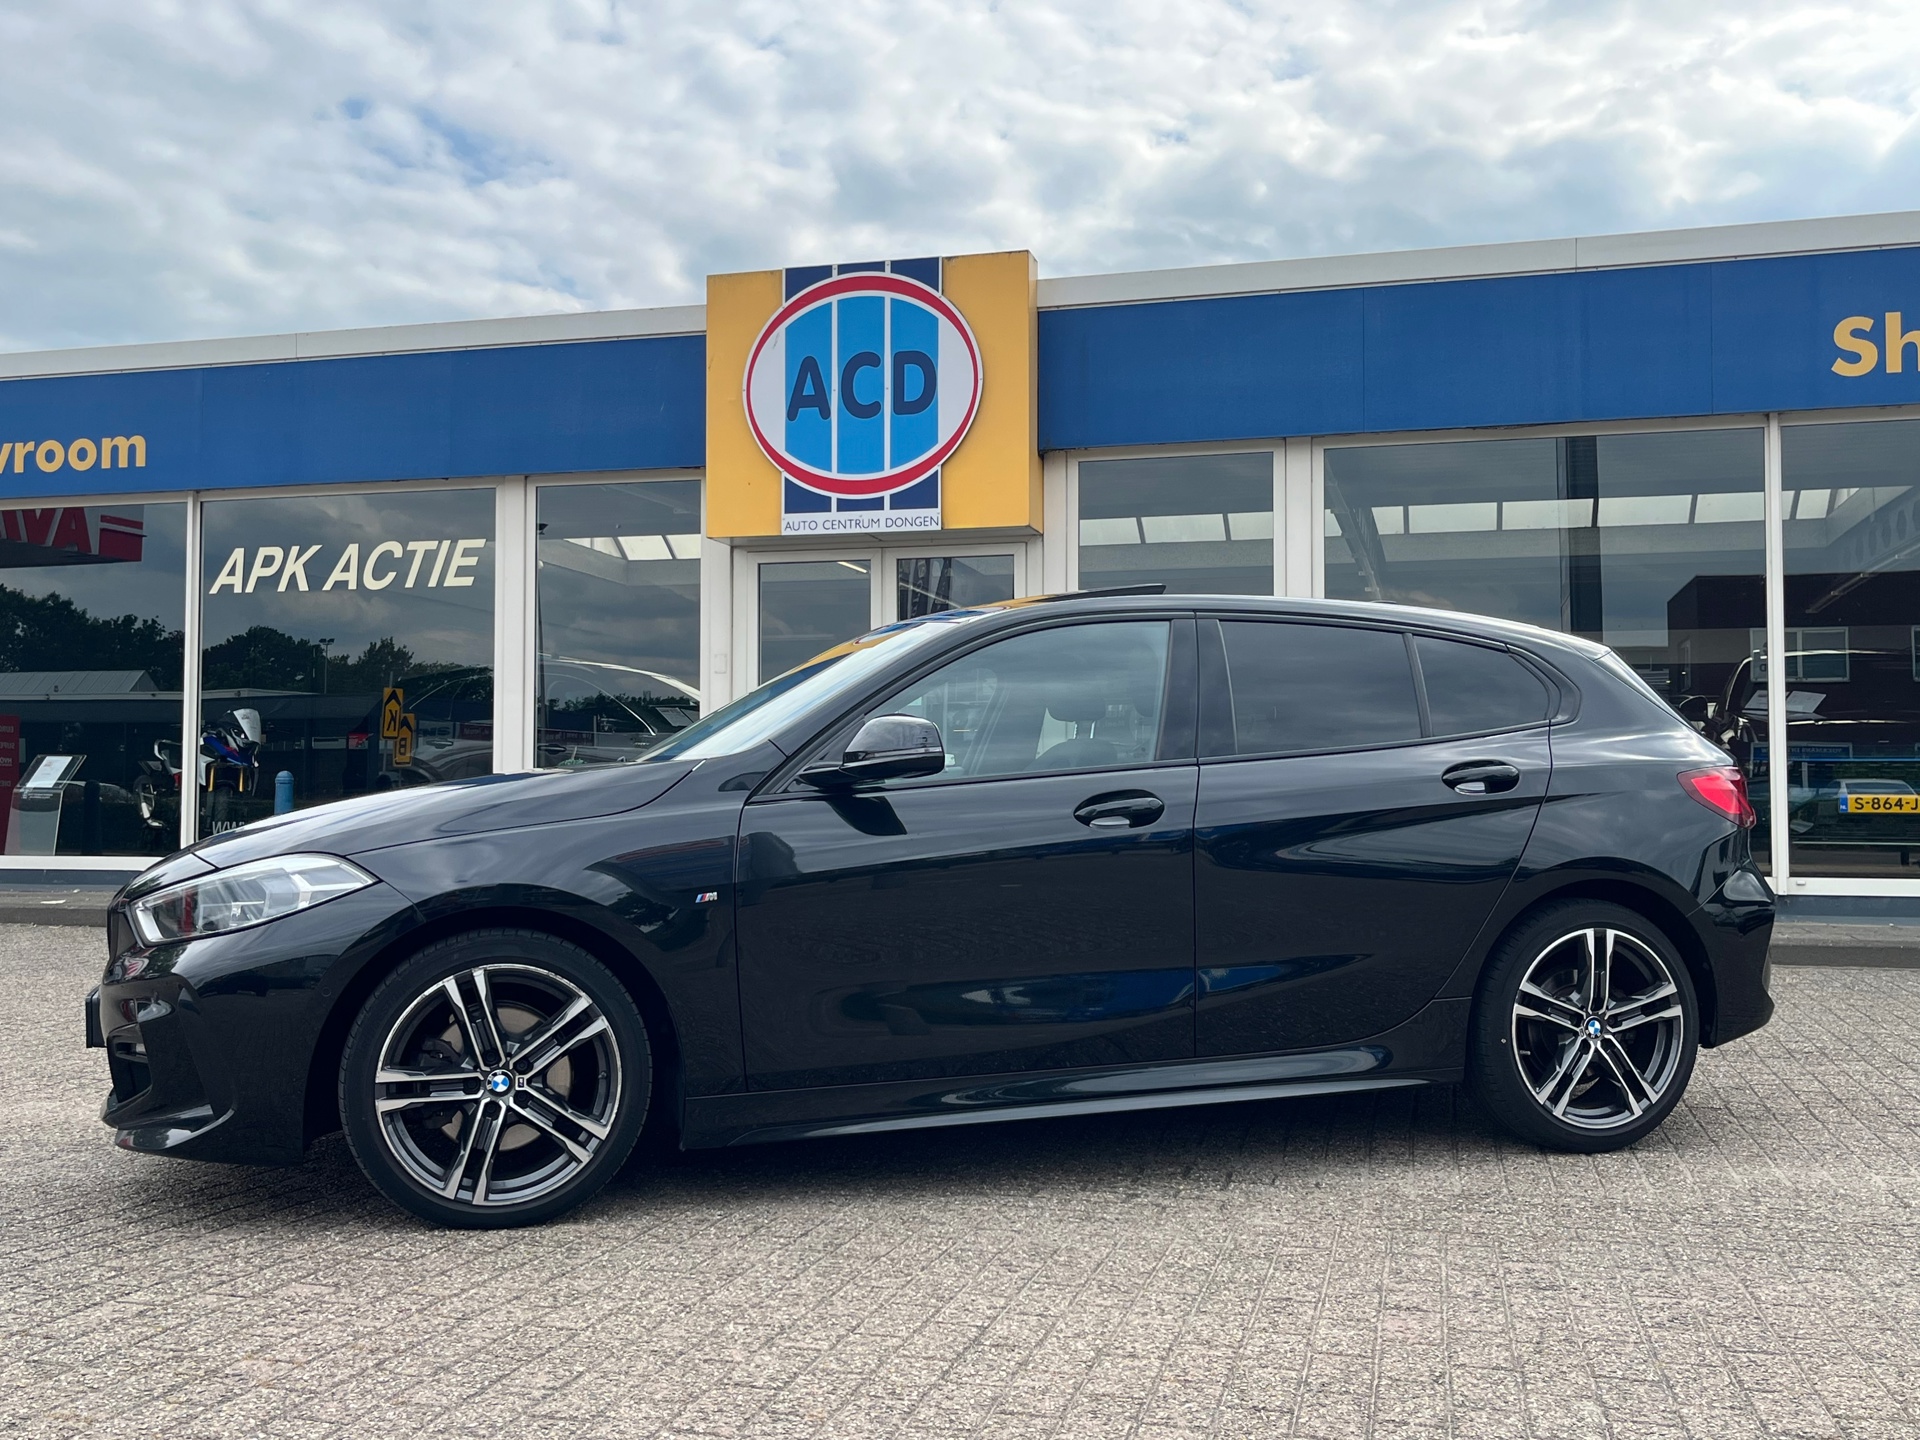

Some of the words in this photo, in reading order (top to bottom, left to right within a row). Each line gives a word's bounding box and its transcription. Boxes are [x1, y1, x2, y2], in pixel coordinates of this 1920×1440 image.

[1830, 311, 1920, 377] Sh
[786, 350, 938, 422] ACD
[784, 520, 818, 531] AUTO
[822, 518, 881, 530] CENTRUM
[885, 516, 939, 528] DONGEN
[209, 544, 323, 594] APK
[322, 538, 487, 591] ACTIE
[1854, 797, 1919, 811] S-864-J
